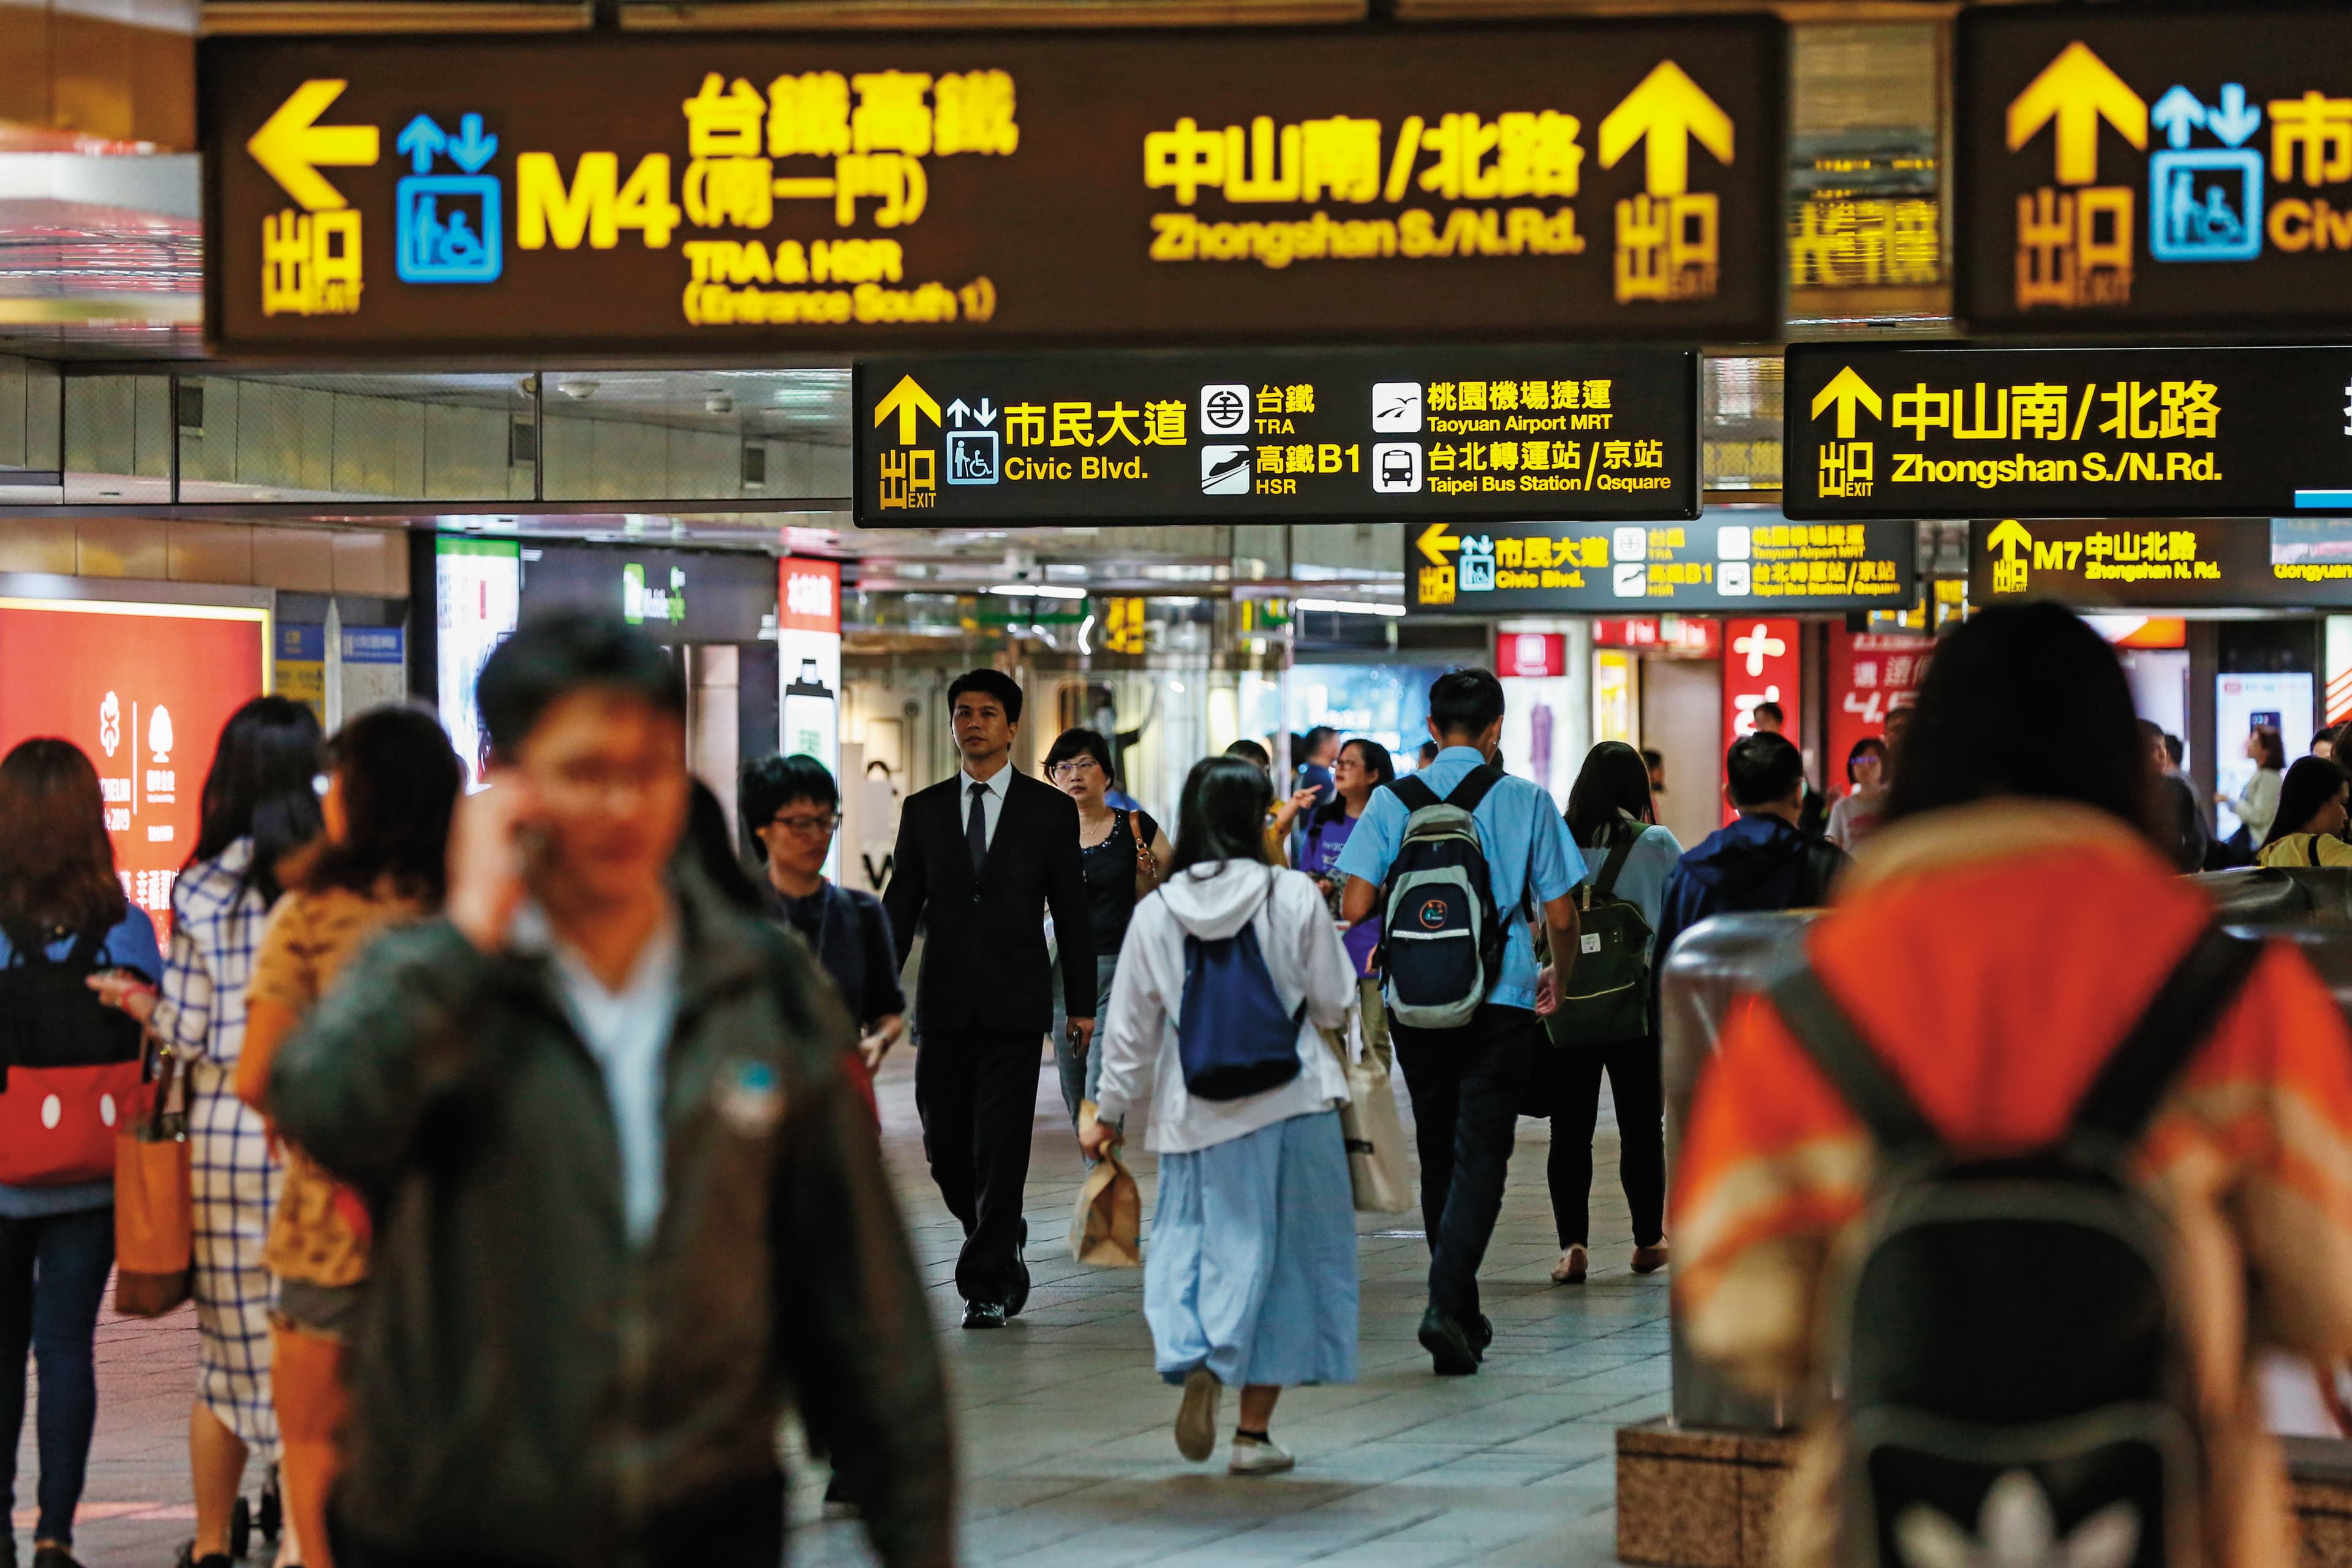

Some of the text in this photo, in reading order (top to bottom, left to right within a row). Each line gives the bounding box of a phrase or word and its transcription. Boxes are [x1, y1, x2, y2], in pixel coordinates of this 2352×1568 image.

[682, 69, 1019, 157] 台鐵高鐵
[2267, 91, 2352, 186] 市
[1144, 110, 1585, 205] 中山南/北路
[516, 151, 681, 250] M4
[1150, 211, 1397, 268] Zhongshan
[1615, 193, 1719, 303] 出口
[2016, 186, 2134, 309] 出口
[262, 209, 363, 317] 出口
[682, 241, 772, 285] TRA
[810, 239, 903, 284] HSR
[1256, 383, 1315, 413] 台鐵
[1427, 379, 1612, 412] 桃園機場捷運
[1892, 380, 2222, 442] 中山南/北路
[1004, 399, 1188, 448] 市民大道
[1256, 419, 1295, 434] TRA
[1427, 413, 1613, 435] Taoyuan Airport MRT
[1005, 456, 1148, 481] Civic Blvd.
[1256, 443, 1359, 474] 高鐵B1
[1819, 442, 1874, 499] 出口
[1891, 453, 2077, 489] Zhongshan
[880, 449, 937, 510] 出口
[1256, 478, 1296, 495] HSR
[1427, 476, 1478, 496] Taipei
[1482, 476, 1517, 492] Bus
[1845, 481, 1874, 497] EXIT
[908, 492, 937, 508] EXIT
[1494, 537, 1609, 568] 市民大道
[2033, 540, 2082, 570] M7
[2085, 530, 2197, 562] 中山北路
[1418, 565, 1456, 605] 出口
[1495, 570, 1586, 589] Civic Blvd.
[1992, 558, 2028, 594] 出口
[2010, 582, 2028, 593] EXIT
[2085, 560, 2221, 582] Zhongshan N. Rd.
